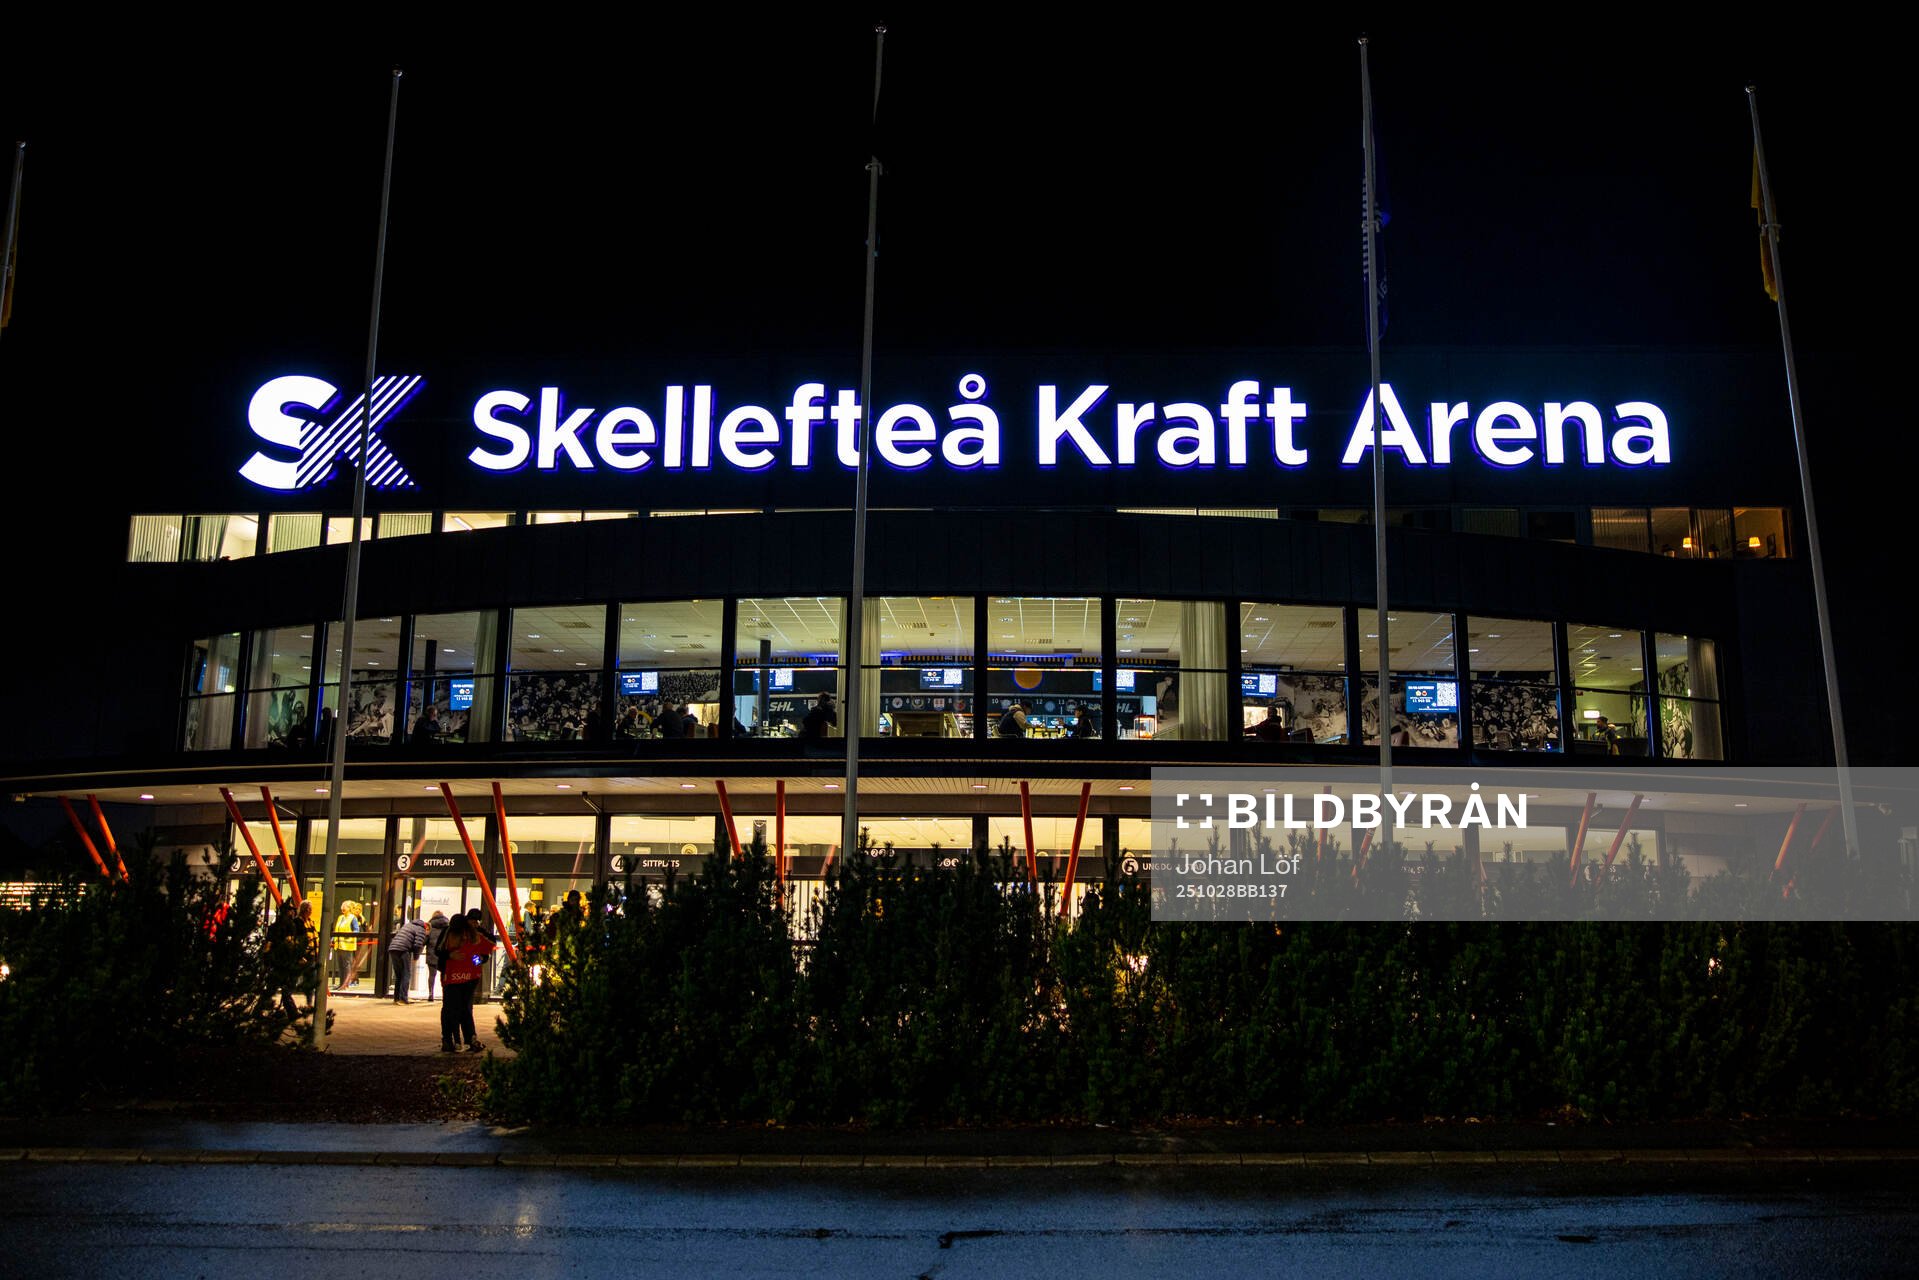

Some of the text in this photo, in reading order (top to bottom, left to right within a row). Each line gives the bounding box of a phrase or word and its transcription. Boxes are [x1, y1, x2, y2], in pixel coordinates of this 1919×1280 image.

[469, 374, 1671, 468] Skellefteå Kraft Arena
[768, 701, 795, 712] SHL
[423, 859, 455, 867] SITTPLATS
[642, 859, 680, 868] SITTPLTS
[451, 972, 472, 981] SSAB
